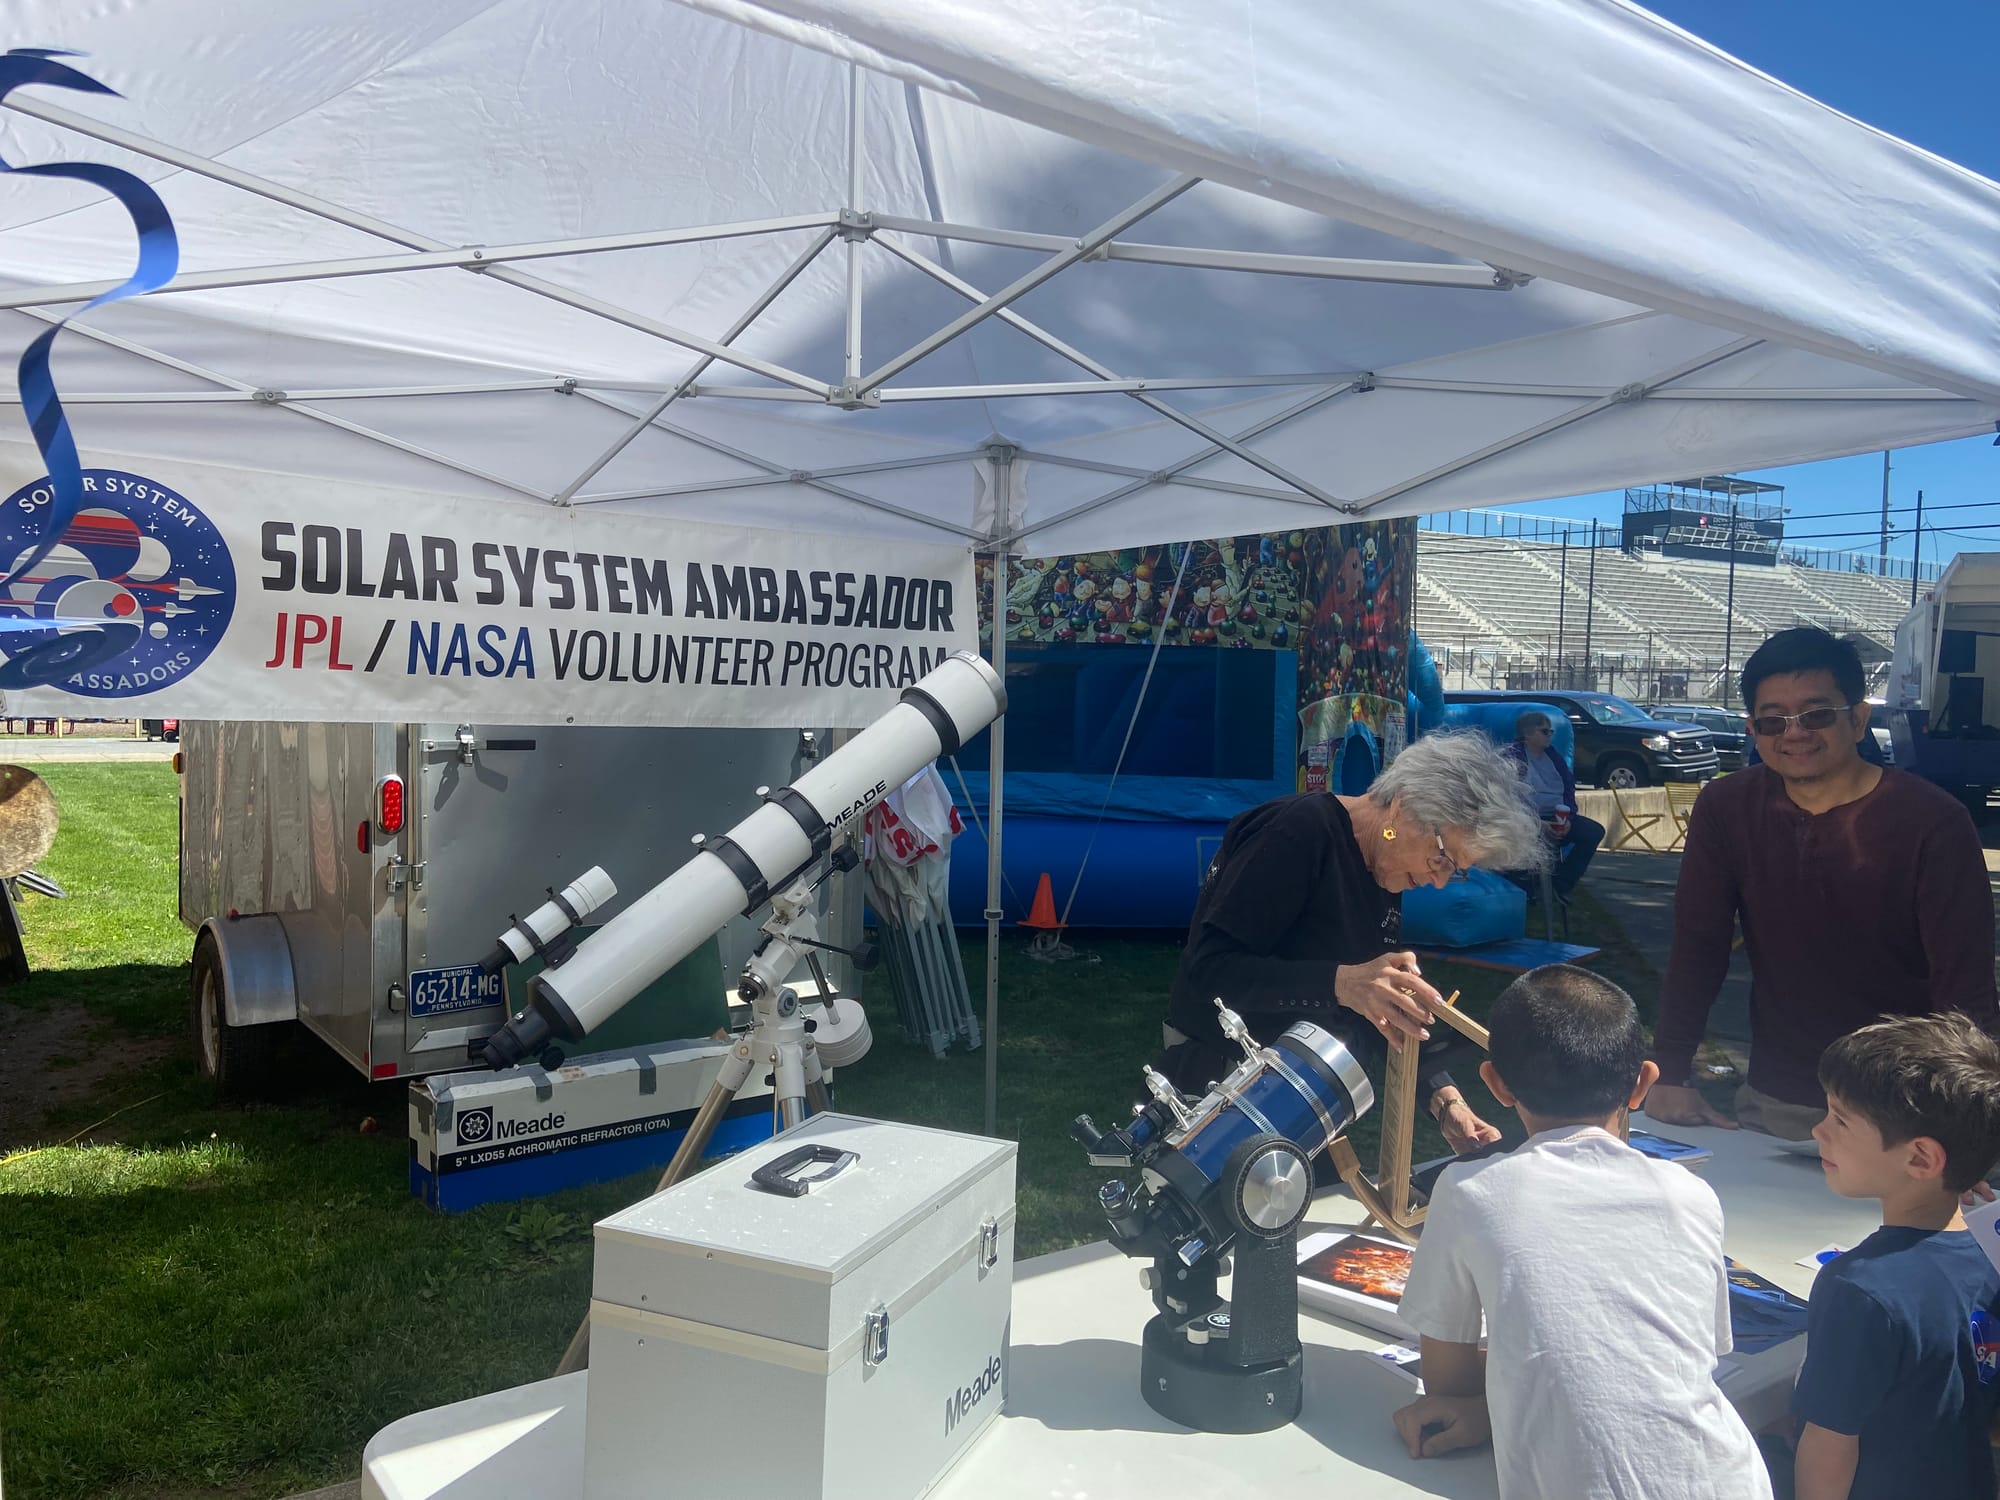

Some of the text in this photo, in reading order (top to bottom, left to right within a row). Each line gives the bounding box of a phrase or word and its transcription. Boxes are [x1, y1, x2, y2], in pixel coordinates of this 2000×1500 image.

[18, 477, 198, 528] SOR SYSTEM
[261, 521, 955, 632] SOLAR SYSTEM AMBASSADOR
[68, 651, 191, 690] ASSADORS
[265, 612, 354, 671] JPL
[407, 620, 536, 680] NASA
[549, 628, 774, 687] VOLUNTEER
[826, 780, 887, 830] MEADE
[416, 974, 499, 1006] 65214-MG
[441, 969, 473, 979] MUNICIPAL
[431, 997, 482, 1012] PENNSYLVANIA
[470, 1149, 505, 1165] LXD55
[507, 1136, 578, 1158] ACHROMATIC
[580, 1123, 643, 1143] REFRACTOR
[644, 1118, 671, 1133] (OTA)
[497, 1112, 565, 1139] Meade
[944, 1354, 1001, 1438] Meade
